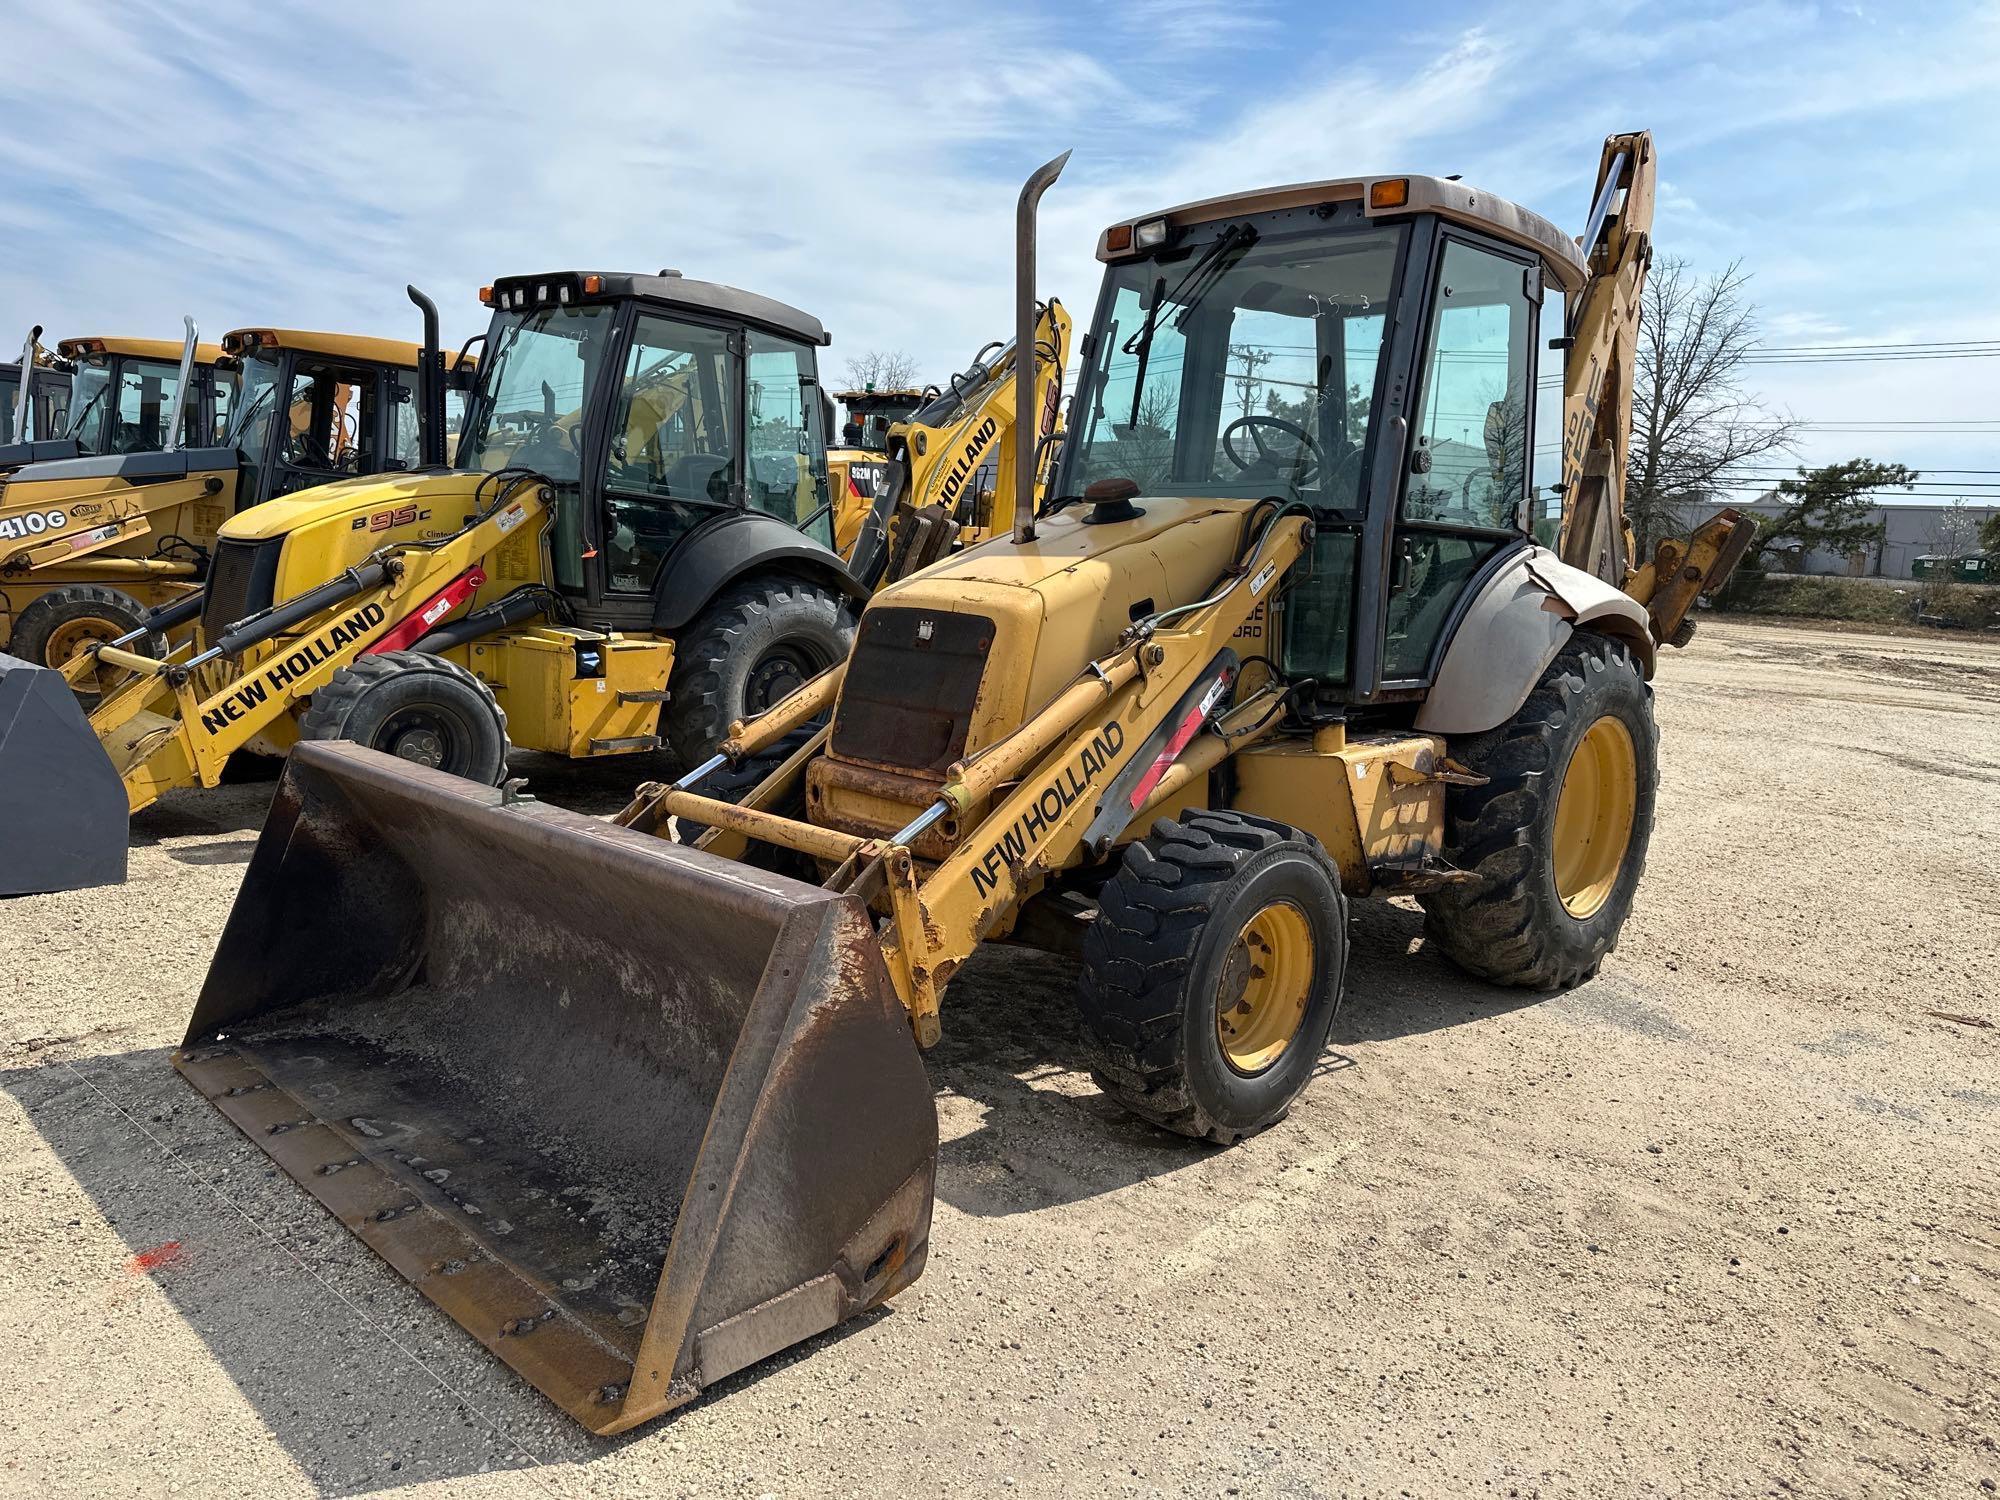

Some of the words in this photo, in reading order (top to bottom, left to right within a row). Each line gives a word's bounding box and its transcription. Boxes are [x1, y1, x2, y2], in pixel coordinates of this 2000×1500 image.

[936, 417, 997, 510] HOLLAND
[0, 509, 67, 540] 410G
[201, 679, 268, 736] NEW
[266, 602, 386, 692] HOLLAND
[1022, 720, 1124, 844] HOLLAND
